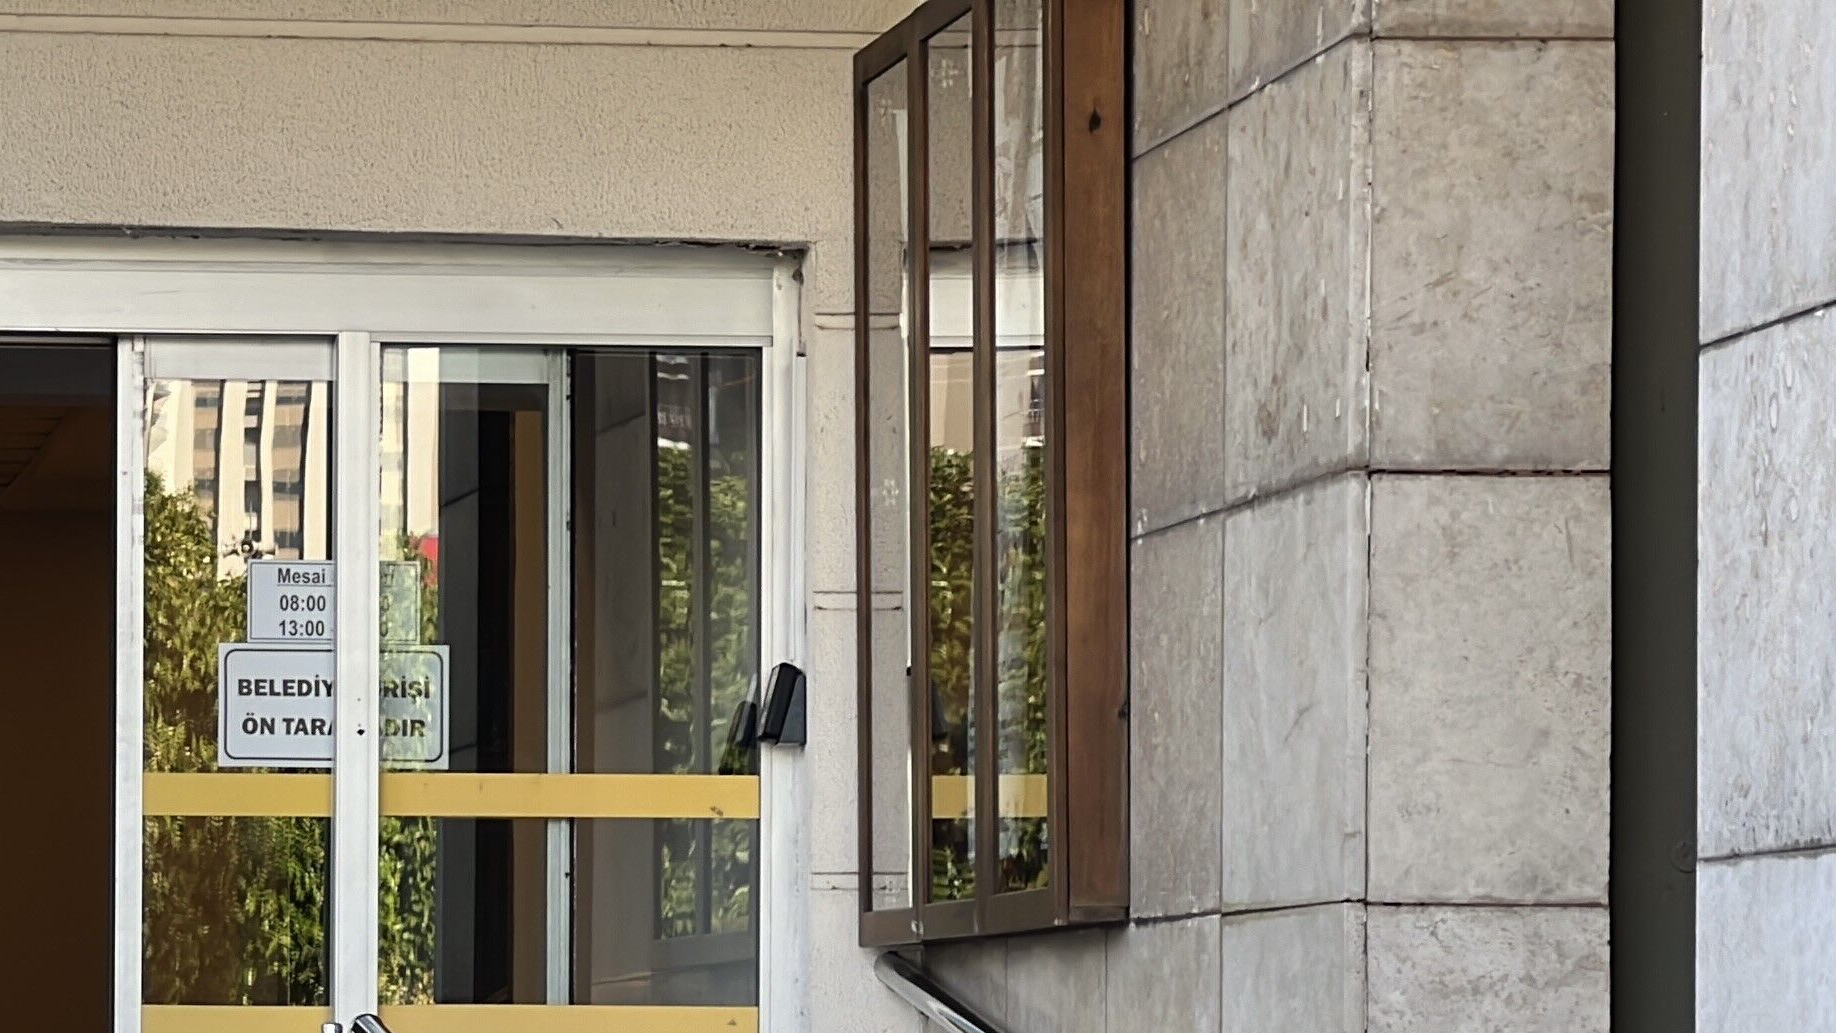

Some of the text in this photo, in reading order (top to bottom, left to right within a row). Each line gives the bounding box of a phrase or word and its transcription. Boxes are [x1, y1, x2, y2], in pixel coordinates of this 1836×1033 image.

[277, 567, 326, 584] Mesai
[279, 594, 326, 612] 08:00
[279, 620, 325, 637] 13:00
[237, 674, 430, 704] BELEDİY RİŞİ
[241, 712, 275, 736] ÖN
